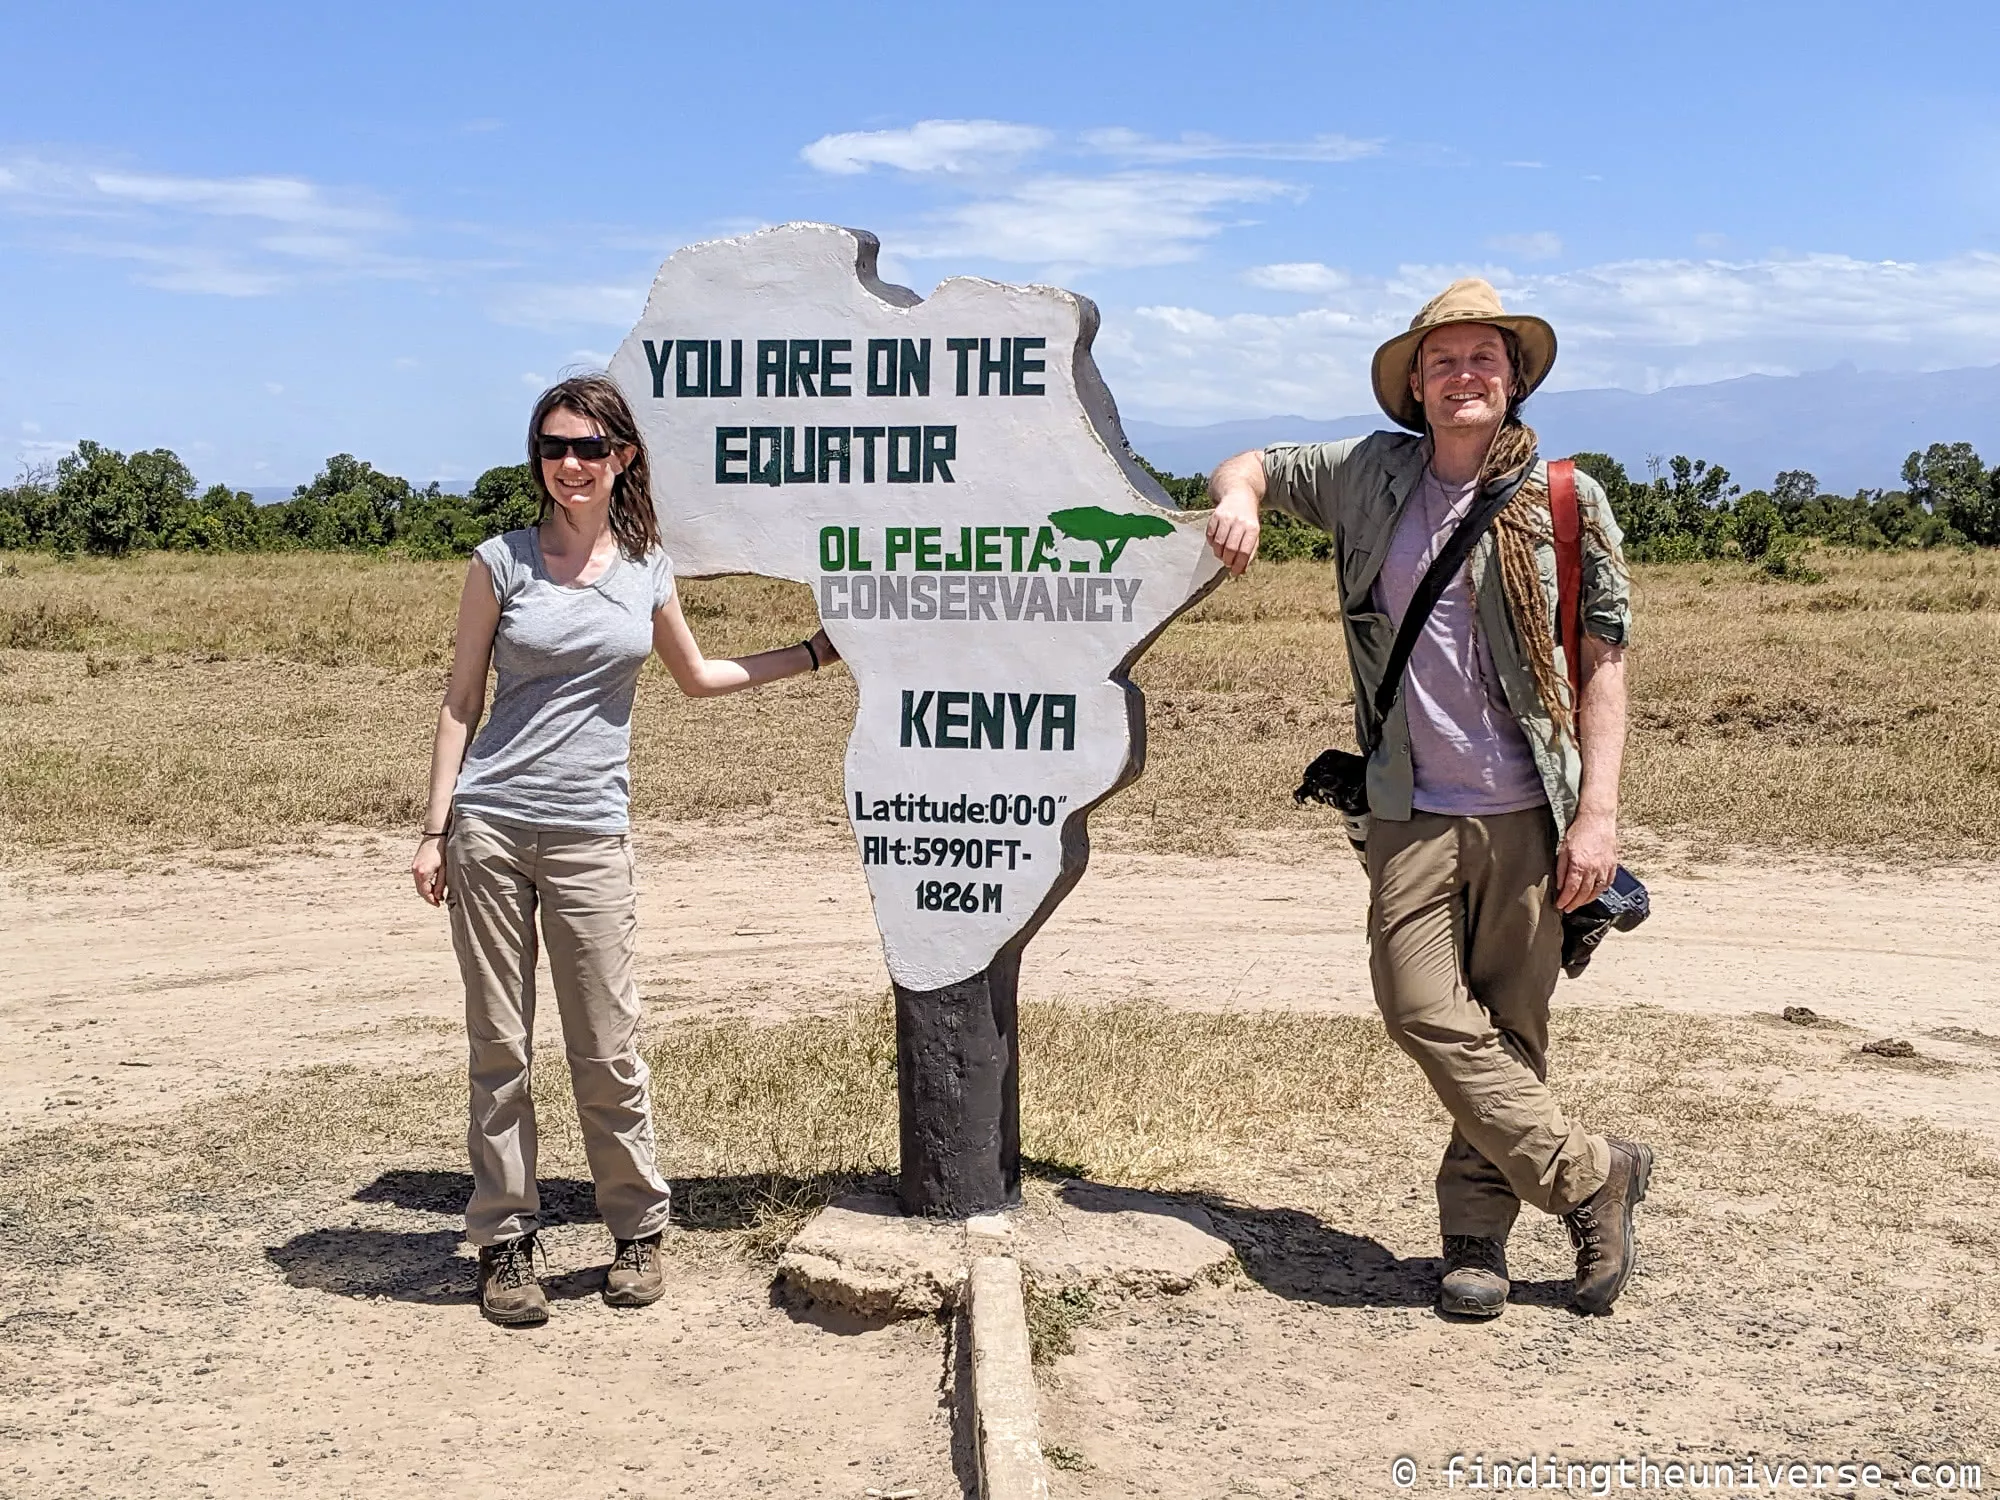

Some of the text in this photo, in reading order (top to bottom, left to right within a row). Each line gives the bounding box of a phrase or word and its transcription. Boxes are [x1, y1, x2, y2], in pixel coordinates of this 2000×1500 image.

[642, 337, 1046, 398] YOU ARE ON THE
[715, 425, 957, 486] EQUATOR
[820, 526, 1061, 572] OL PEJETA
[820, 575, 1142, 622] CONSERVANCY
[900, 689, 1076, 751] KENYA
